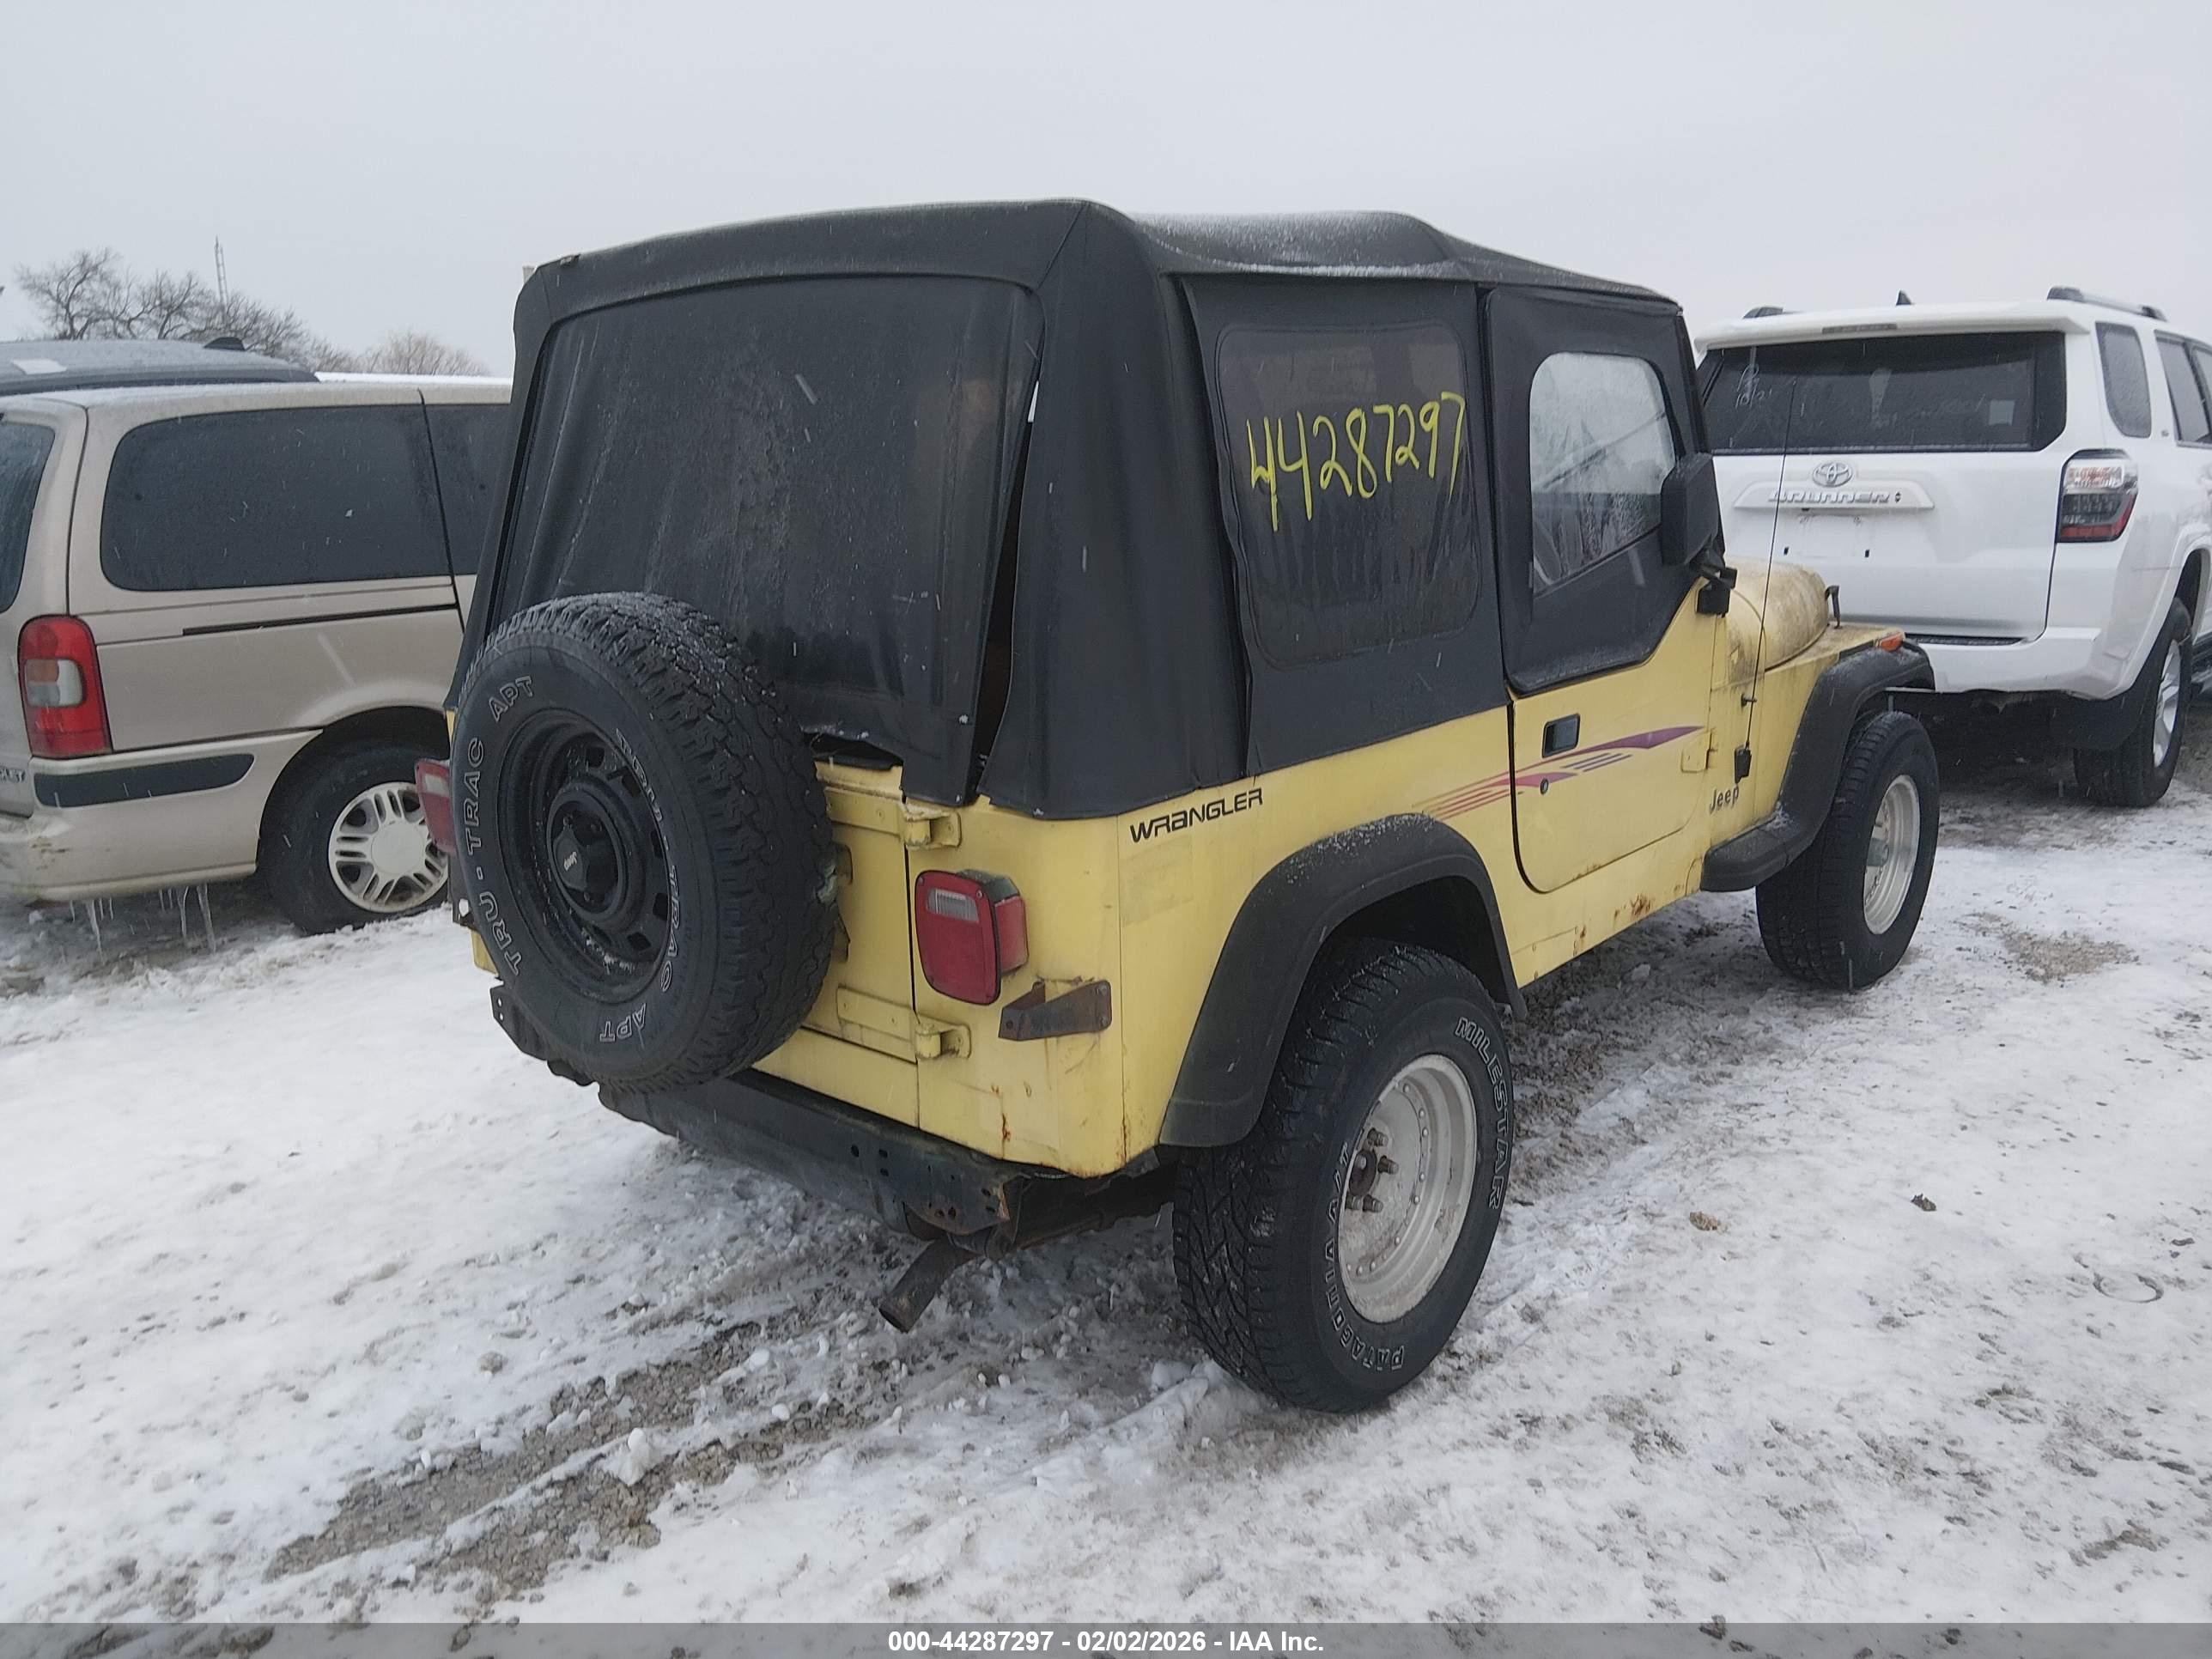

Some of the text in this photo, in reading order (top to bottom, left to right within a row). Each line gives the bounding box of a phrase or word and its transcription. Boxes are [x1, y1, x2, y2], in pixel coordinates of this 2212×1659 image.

[1246, 391, 1466, 532] 44287297
[489, 675, 533, 721] APT
[463, 737, 484, 855] TRAC
[1709, 784, 1740, 815] Jeep
[479, 890, 522, 975] TRU
[1455, 1016, 1509, 1210] MILESTAR
